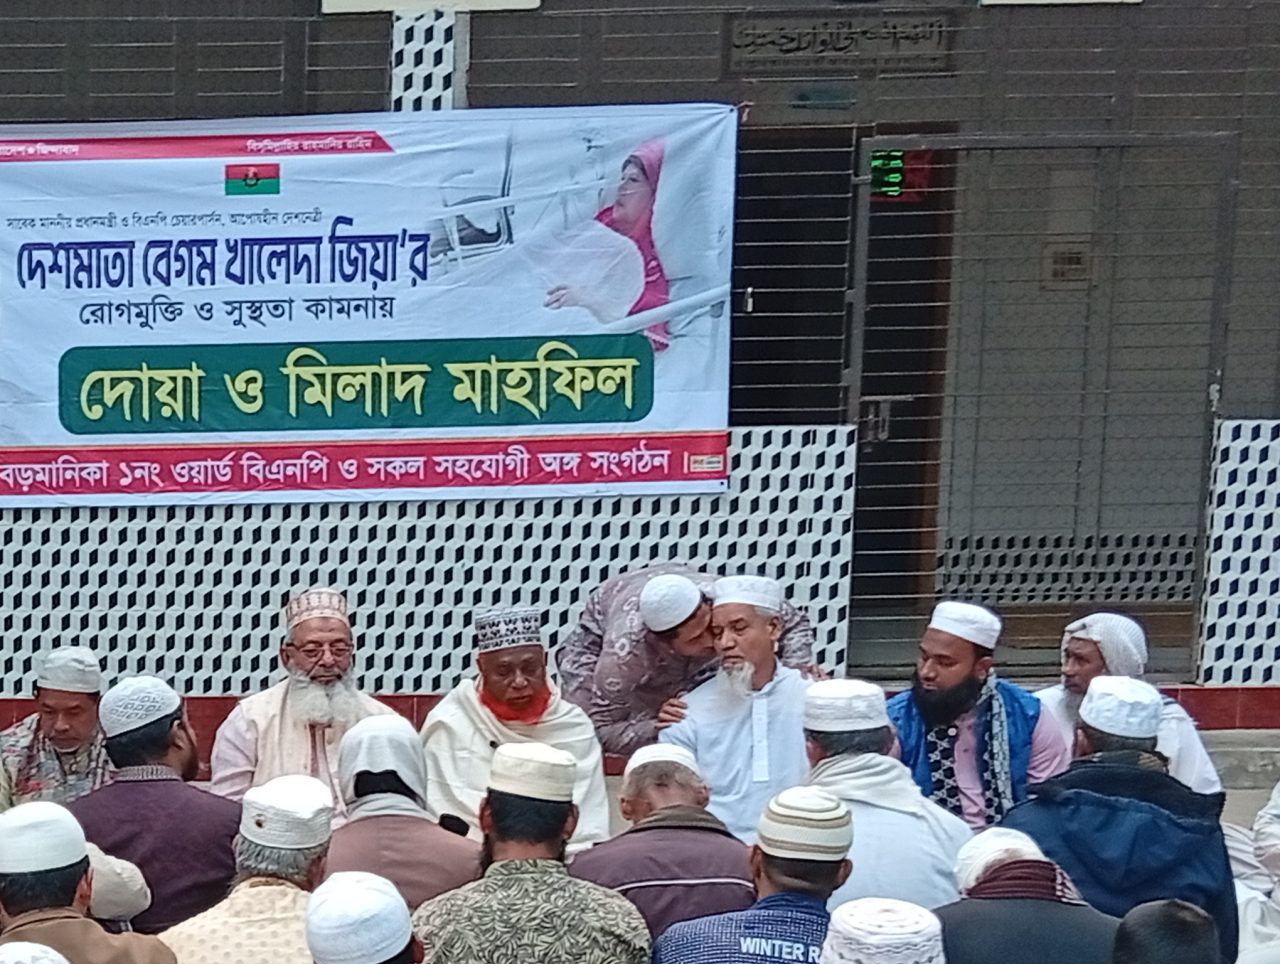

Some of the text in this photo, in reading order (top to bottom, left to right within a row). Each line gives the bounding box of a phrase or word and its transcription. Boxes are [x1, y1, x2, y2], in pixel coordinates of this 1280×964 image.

[6, 217, 36, 229] সাবেক
[39, 212, 72, 228] মাননীয়
[121, 215, 129, 227] ও
[132, 211, 168, 226] বিএনপি
[17, 240, 135, 289] দেশমাতা
[142, 238, 218, 287] বেগম
[225, 235, 323, 285] খালেদা
[79, 294, 397, 330] রোগমুক্তি ও সুস্থতা কামনায়
[80, 340, 641, 422] দোয়া ও মিলাদ মাহফিল
[119, 460, 165, 488] ১নং
[170, 451, 238, 485] ওয়ার্ড
[239, 450, 330, 484] বিএনপি
[337, 458, 358, 480] ও
[364, 455, 427, 481] সকল
[433, 444, 531, 482] সহযোগী
[537, 451, 582, 477] অঙ্গ
[587, 440, 671, 477] সংগঠন
[740, 936, 804, 961] WINTER
